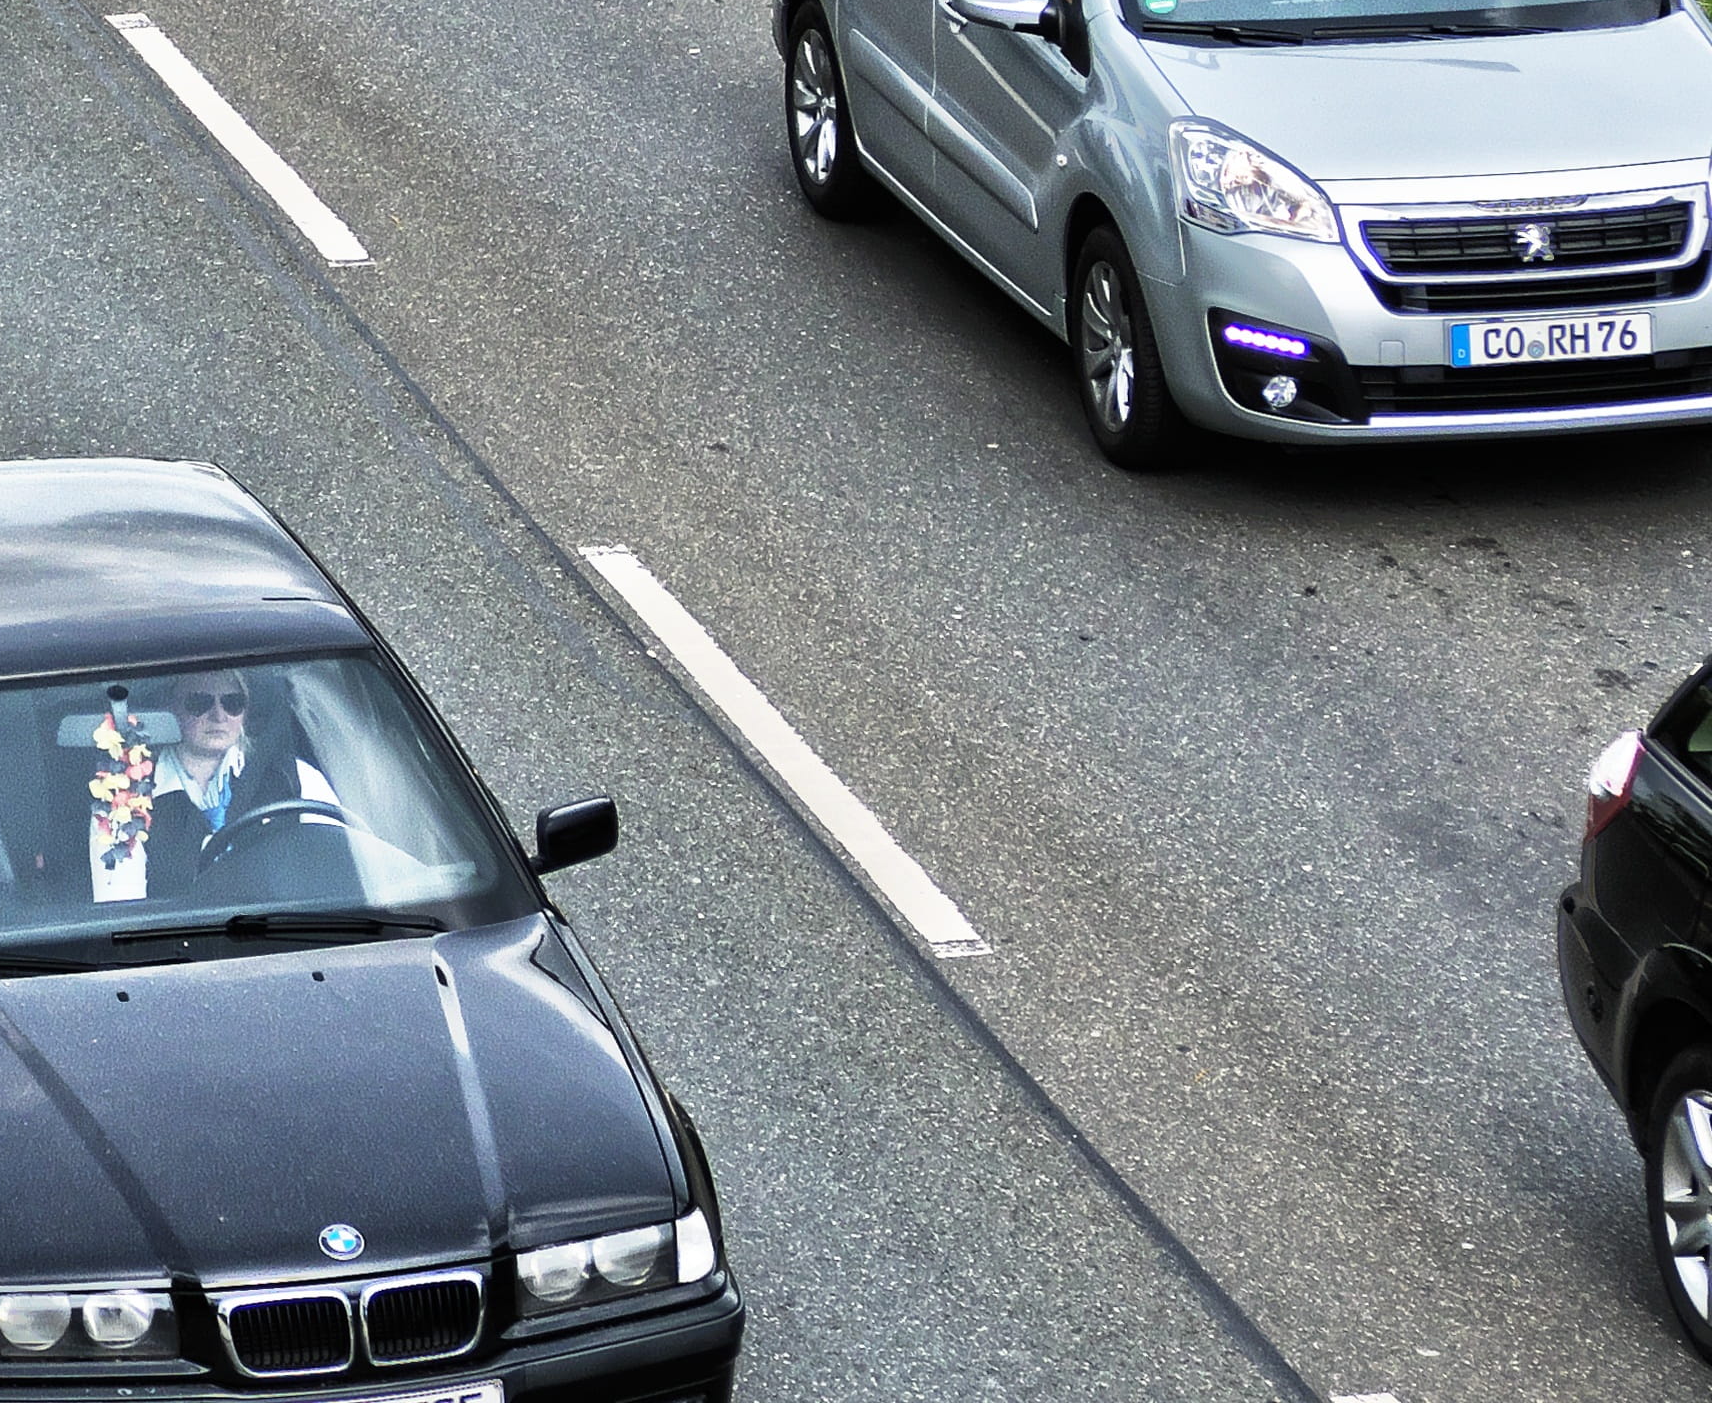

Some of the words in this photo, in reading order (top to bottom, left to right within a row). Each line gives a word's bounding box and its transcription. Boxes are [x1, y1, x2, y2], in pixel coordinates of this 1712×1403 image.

[1483, 327, 1525, 359] CO
[1548, 322, 1590, 356] RH
[1597, 319, 1638, 352] 76
